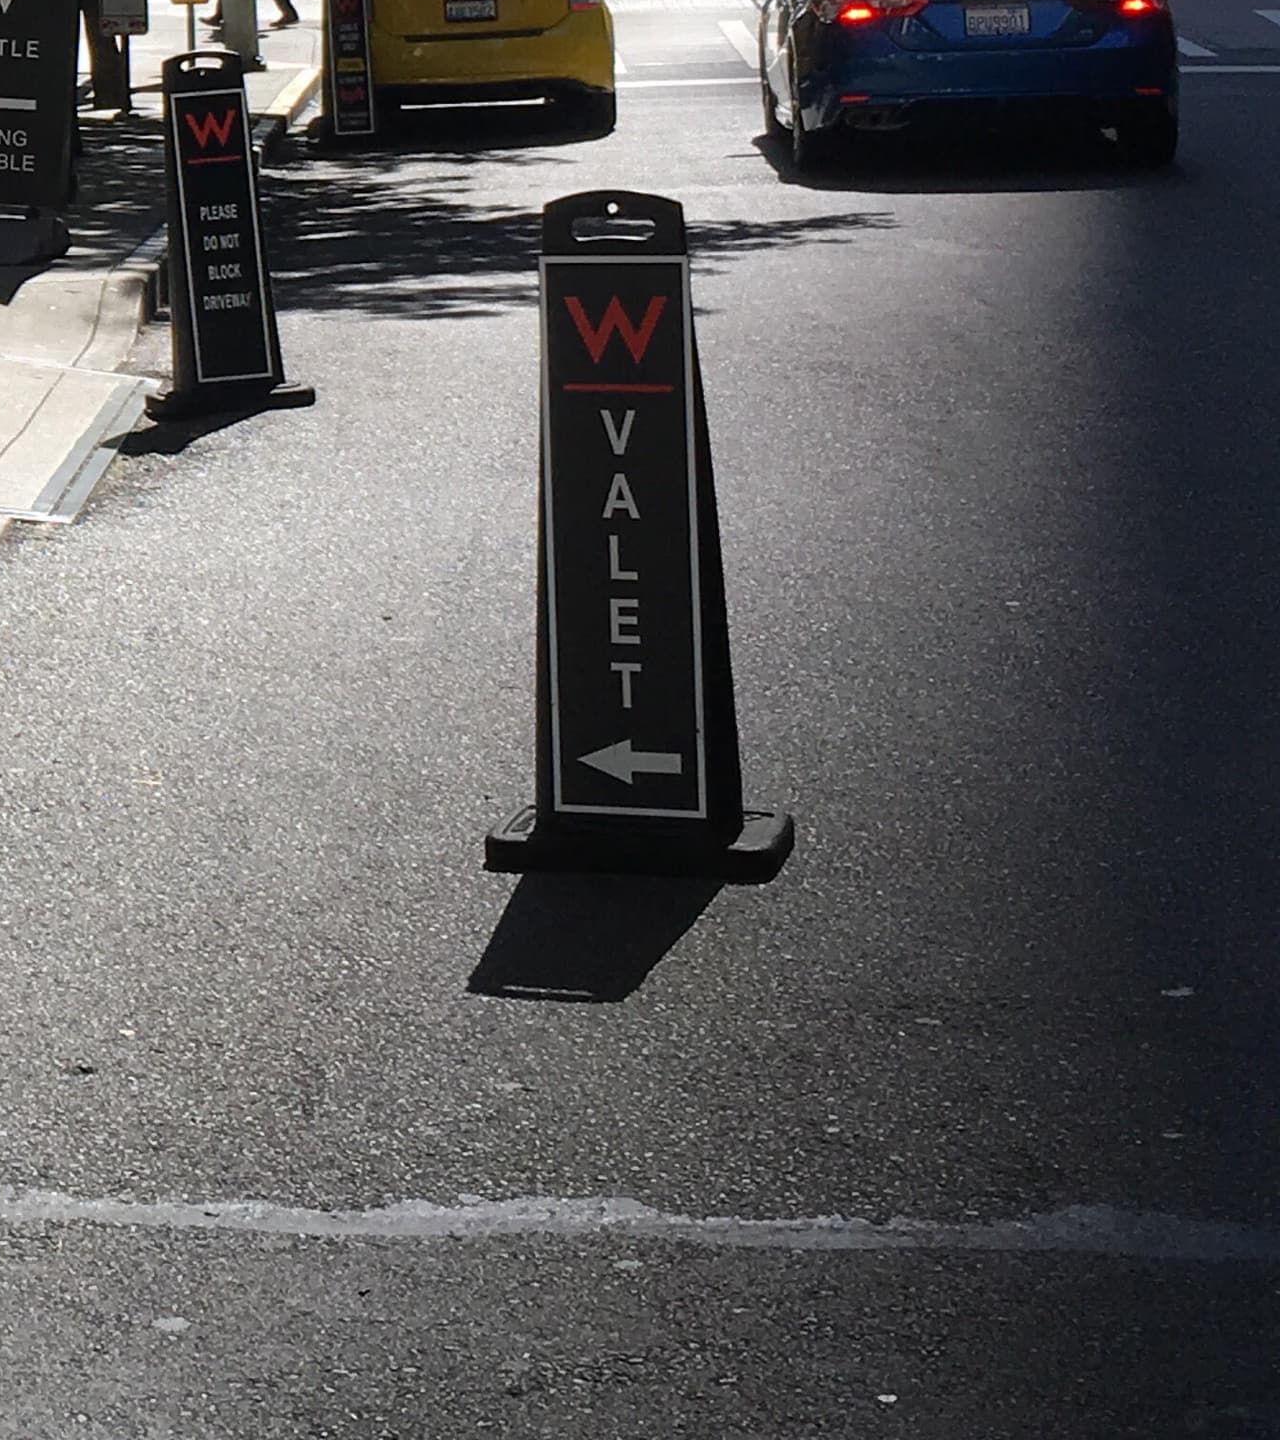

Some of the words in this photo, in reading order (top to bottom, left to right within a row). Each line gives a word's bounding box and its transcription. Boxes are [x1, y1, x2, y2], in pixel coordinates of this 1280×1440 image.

[184, 108, 237, 149] W
[200, 203, 239, 221] PLEASE
[203, 235, 219, 252] DO
[220, 233, 240, 249] NOT
[207, 263, 242, 281] BLOCK
[202, 292, 252, 311] DRIVEWAY
[562, 295, 668, 364] W
[600, 408, 643, 709] VALET
